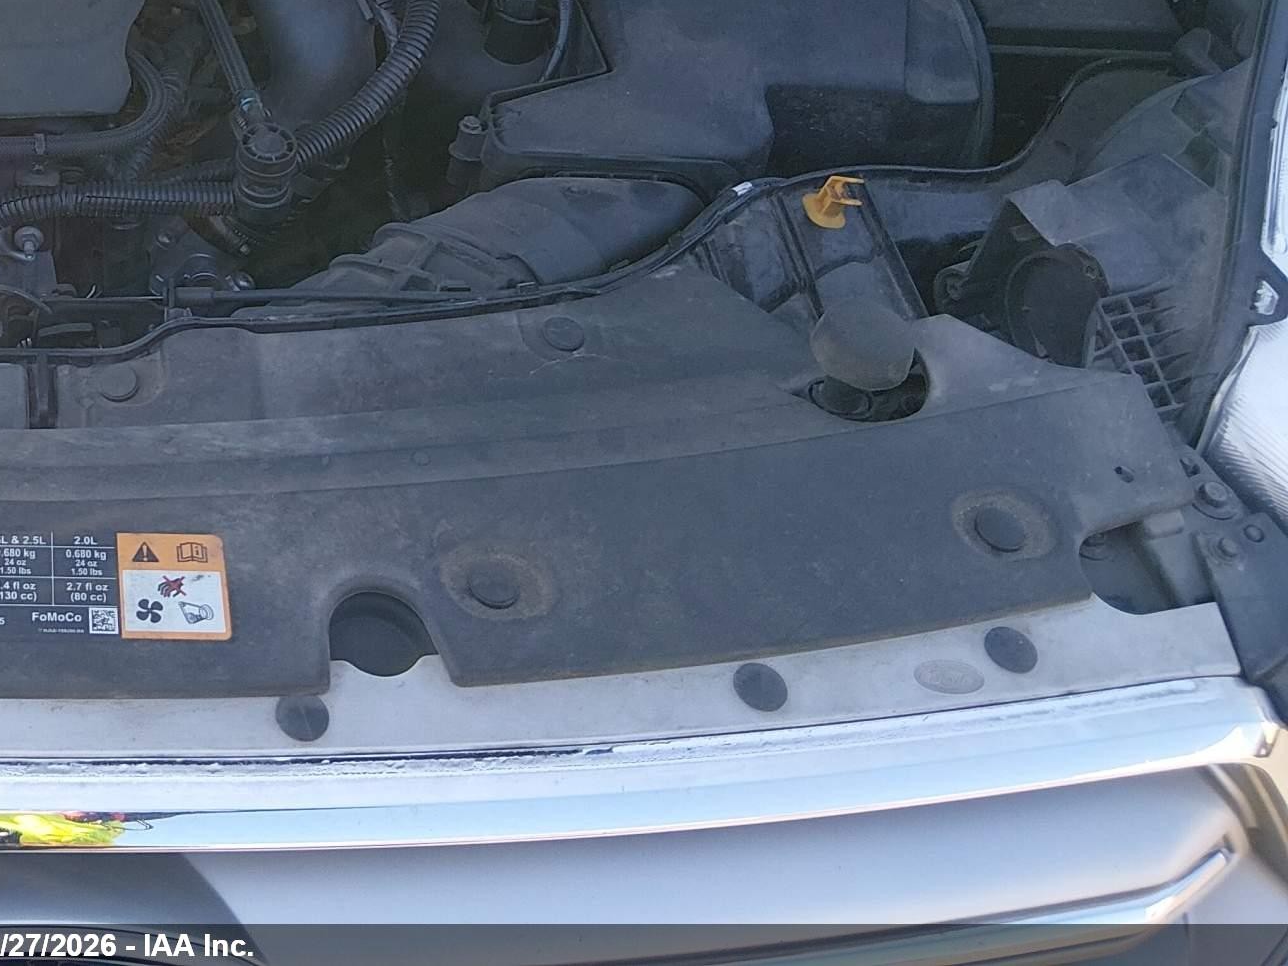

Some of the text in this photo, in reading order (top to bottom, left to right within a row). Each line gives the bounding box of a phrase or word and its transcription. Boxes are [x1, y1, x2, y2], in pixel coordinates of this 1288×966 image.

[11, 535, 20, 545] &
[22, 535, 47, 545] 2.5L
[73, 536, 98, 546] 2.0L
[23, 548, 36, 560] kg
[65, 549, 107, 561] 0.680 kg
[4, 558, 15, 566] 24
[75, 559, 86, 567] 24
[0, 567, 32, 575] 1.50 lbs
[71, 568, 103, 576] 1.50 lbs
[12, 581, 20, 590] fl
[22, 582, 37, 591] oz
[66, 582, 109, 592] 2.7 fl oz
[20, 591, 38, 602] cc)
[70, 592, 107, 603] (80 cc)
[31, 611, 83, 622] FoMoCo
